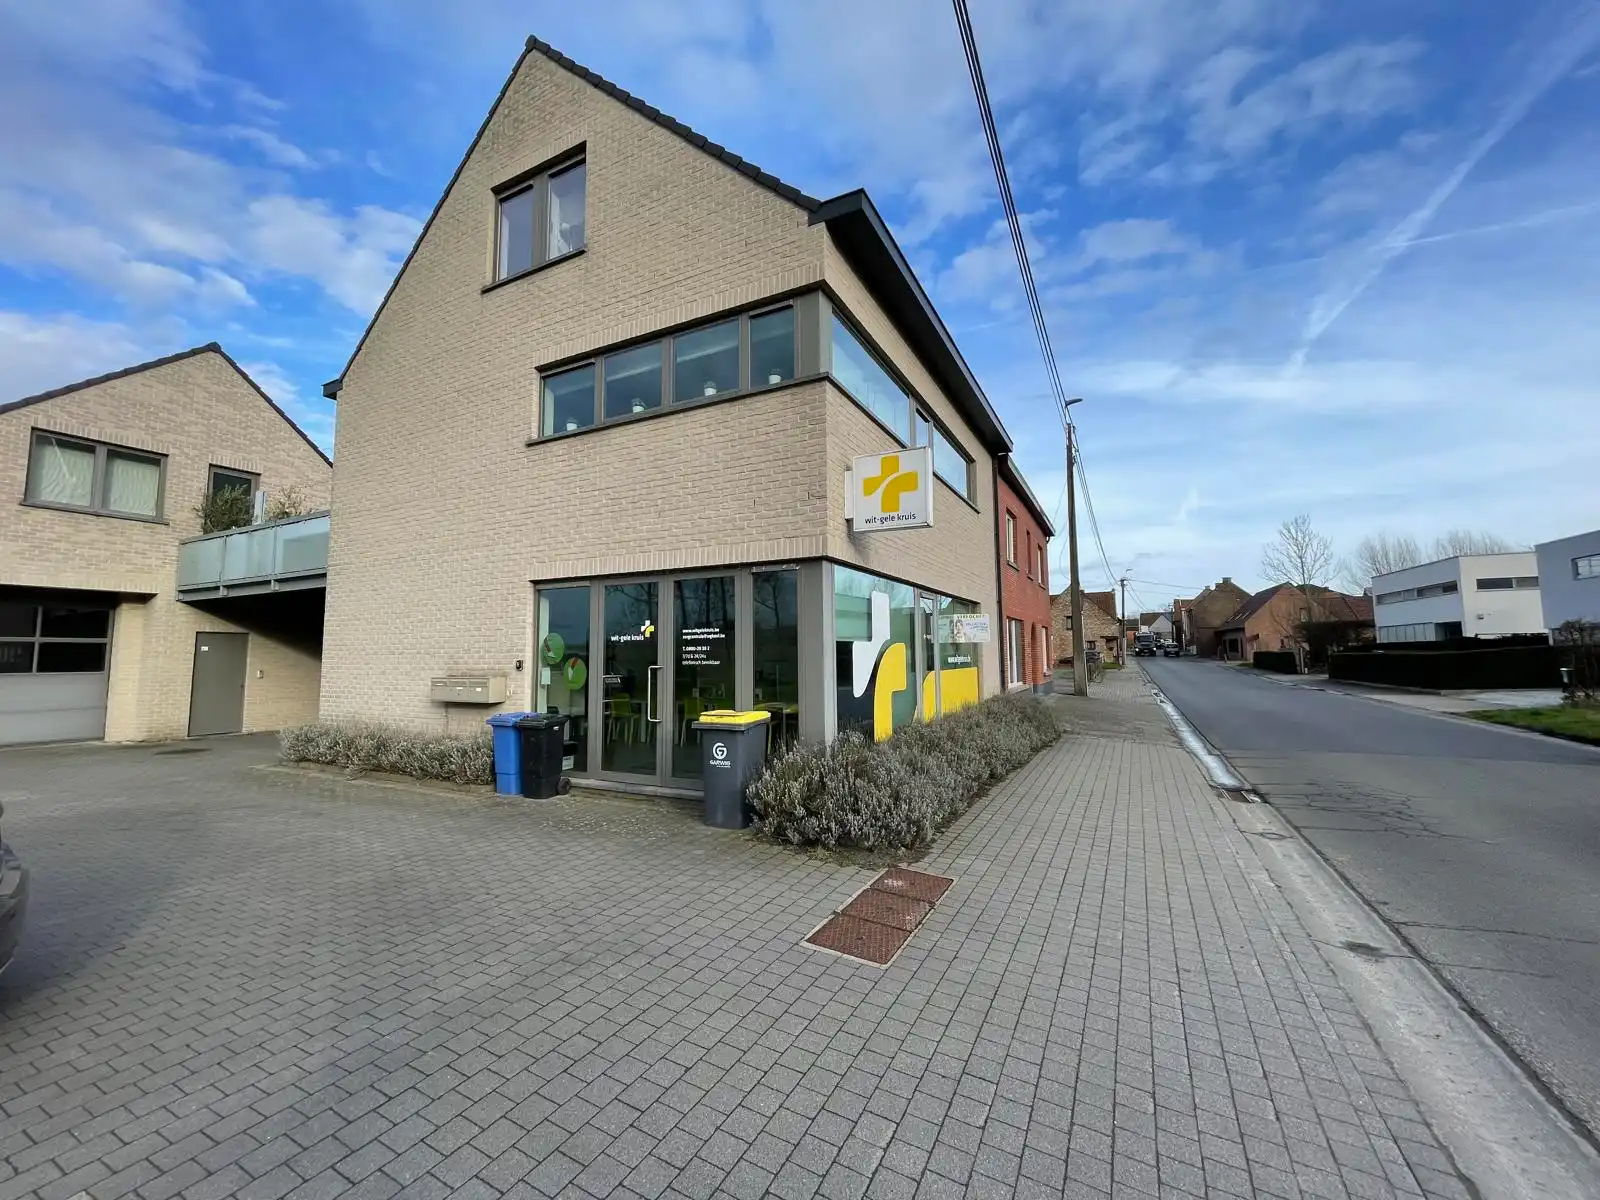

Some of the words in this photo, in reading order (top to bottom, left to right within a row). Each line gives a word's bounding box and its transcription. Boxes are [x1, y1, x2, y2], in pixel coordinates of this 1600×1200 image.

[865, 514, 896, 525] wit-gele
[897, 512, 916, 521] kruis
[610, 634, 631, 643] wit-gele
[631, 633, 645, 641] kruis
